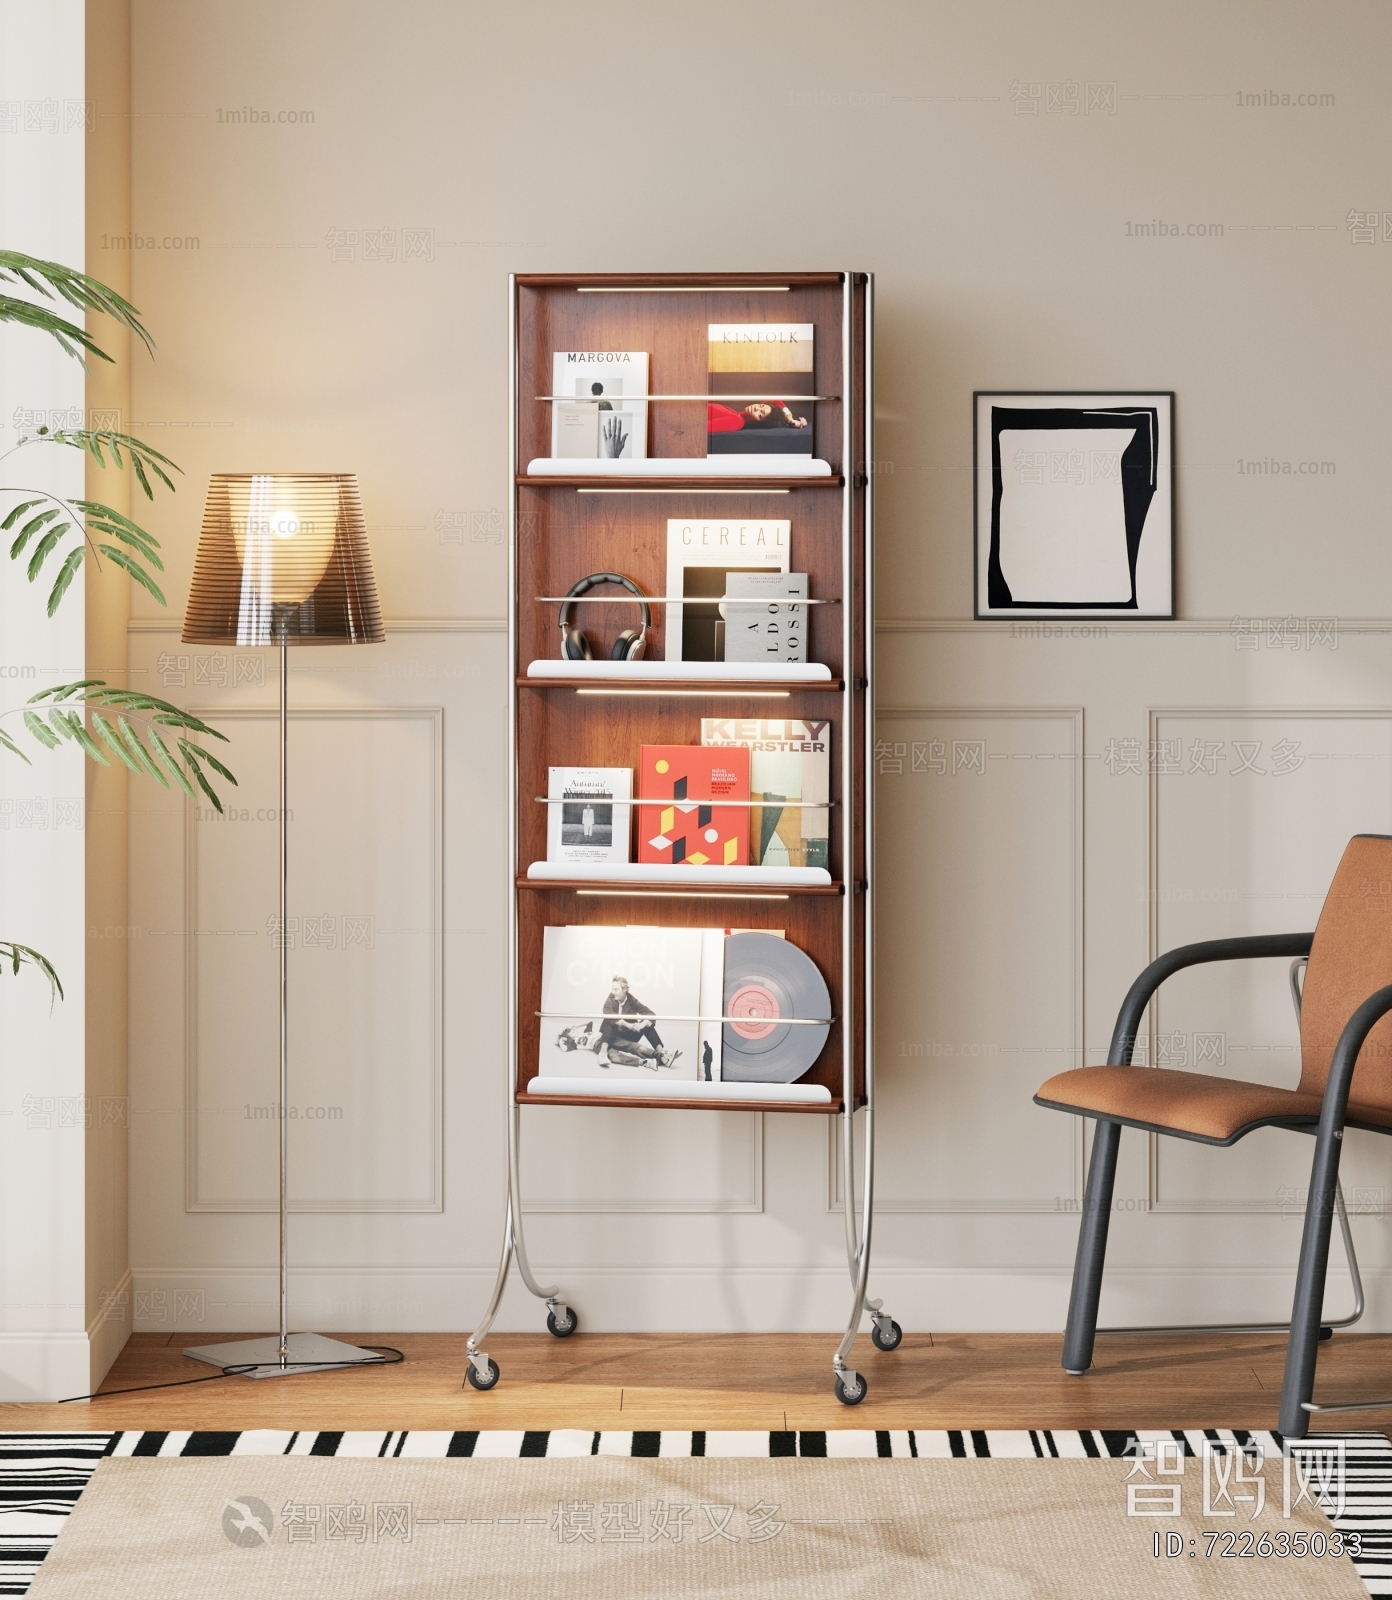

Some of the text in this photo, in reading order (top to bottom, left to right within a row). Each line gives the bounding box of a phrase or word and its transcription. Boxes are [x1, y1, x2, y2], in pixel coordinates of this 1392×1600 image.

[723, 332, 798, 344] KINFOLK
[567, 353, 631, 363] MARGOVA
[682, 526, 784, 545] CEREAL
[705, 720, 829, 741] KELLY
[706, 740, 825, 753] WEARSTLER
